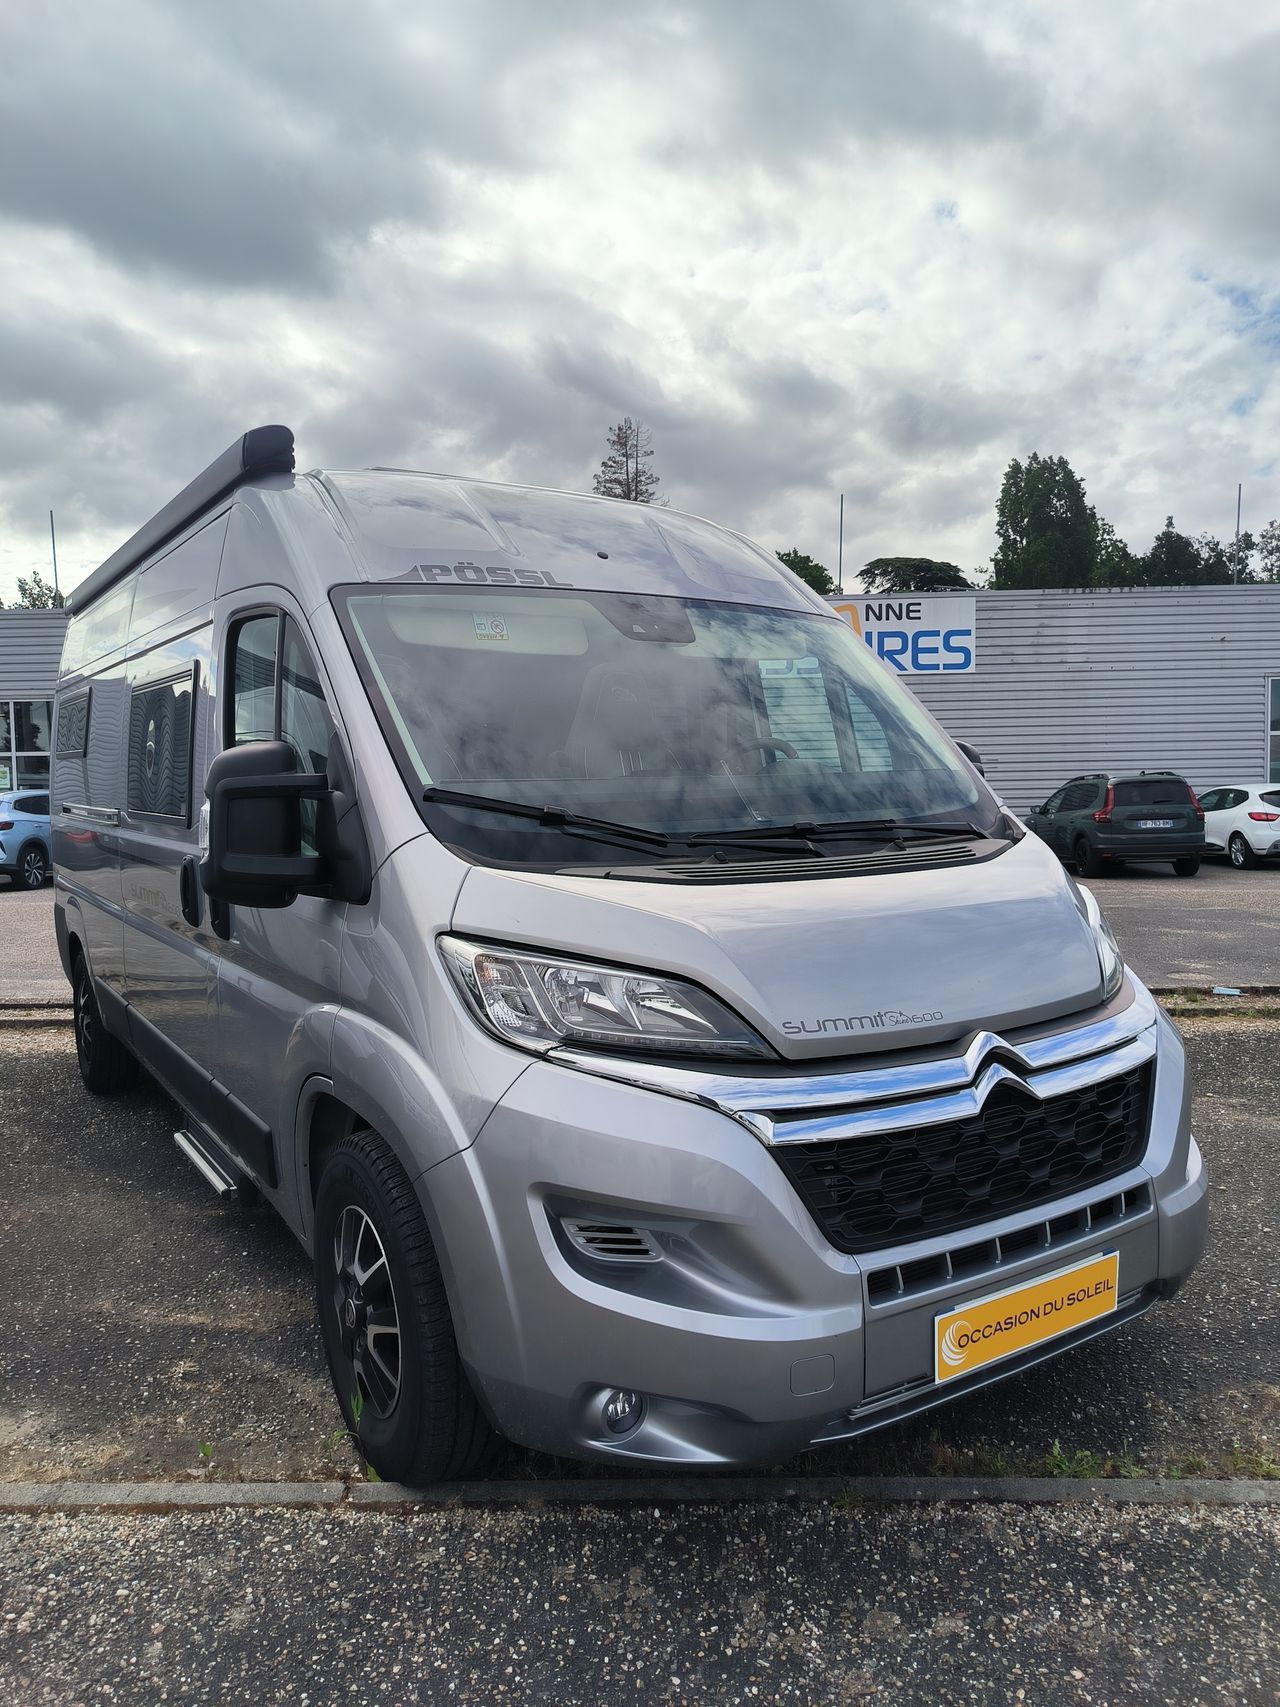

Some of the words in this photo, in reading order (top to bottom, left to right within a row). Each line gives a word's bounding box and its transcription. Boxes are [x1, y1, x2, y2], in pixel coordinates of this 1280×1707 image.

[419, 562, 574, 588] PÖSSL
[911, 1011, 944, 1023] 600
[957, 1306, 1041, 1349] OCCASION
[1043, 1297, 1064, 1317] DU
[1066, 1278, 1114, 1307] SOLEIL
